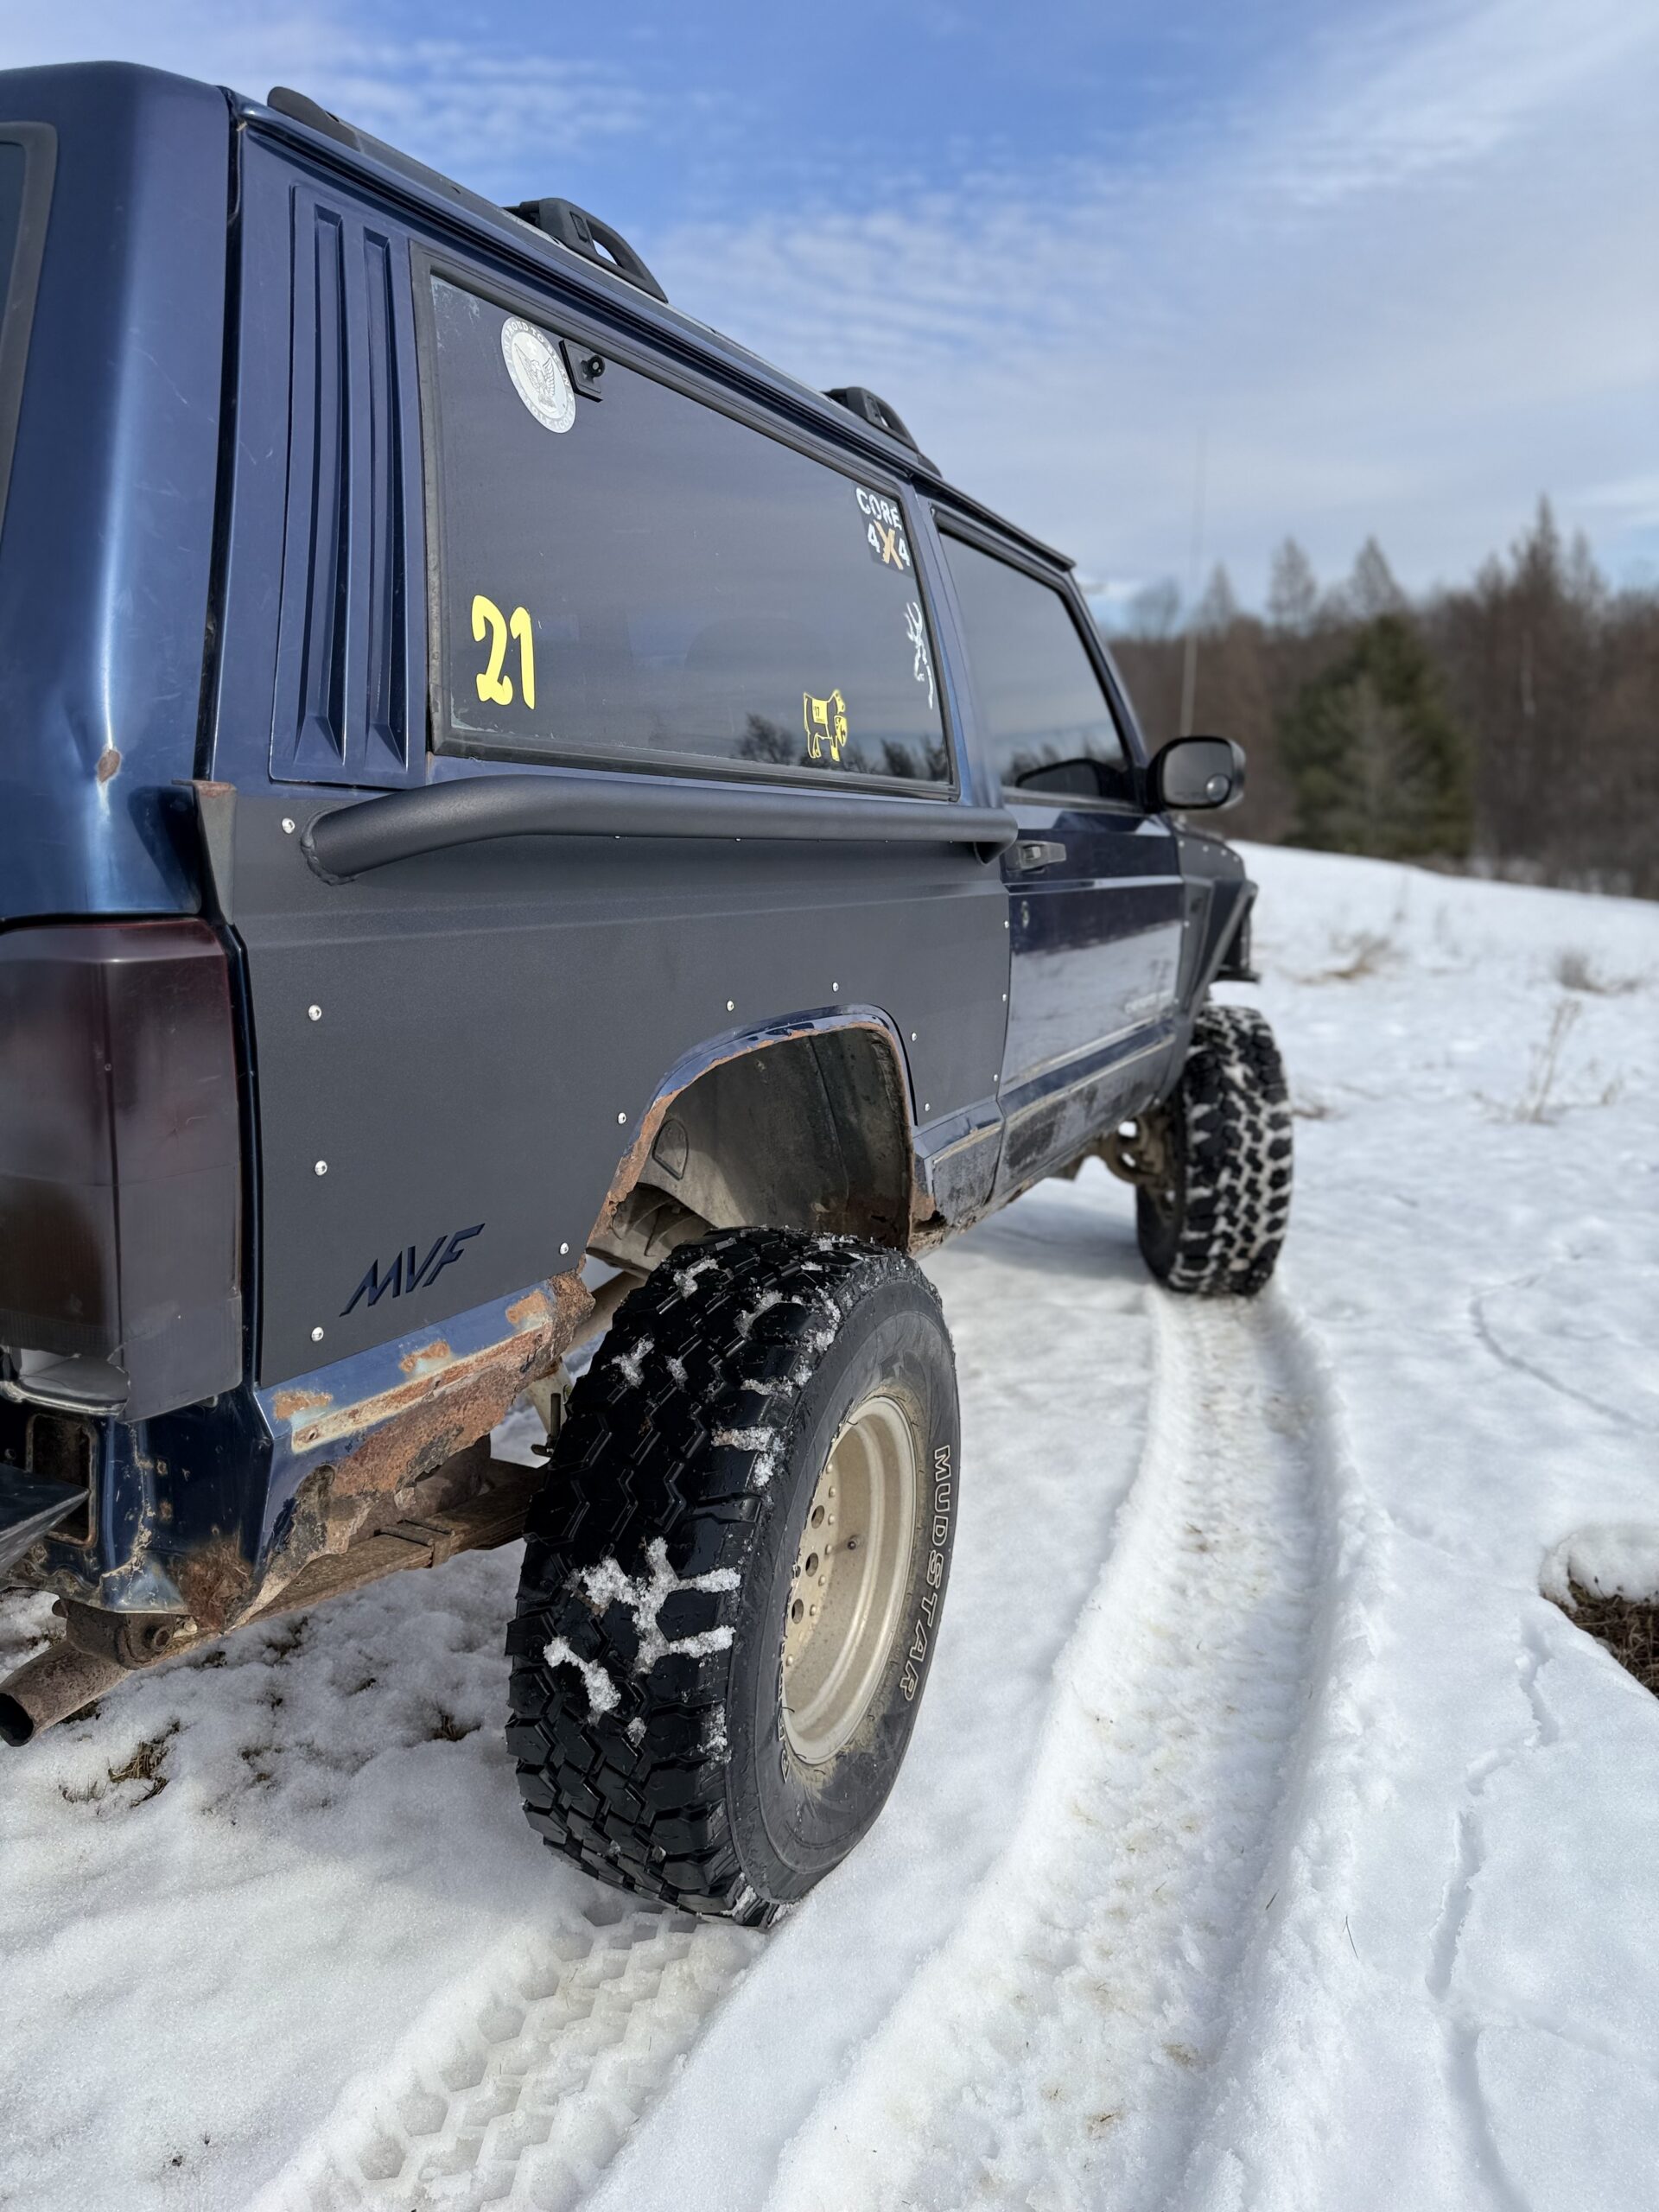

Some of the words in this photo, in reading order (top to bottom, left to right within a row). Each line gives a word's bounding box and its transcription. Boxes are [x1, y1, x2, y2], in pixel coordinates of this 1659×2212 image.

[505, 321, 529, 338] PROUD
[531, 327, 544, 343] TO
[855, 487, 903, 530] CORE
[867, 519, 910, 570] 4X4
[471, 594, 536, 710] 21
[339, 1223, 486, 1318] MVF
[899, 1445, 950, 1701] MUDSTAR
